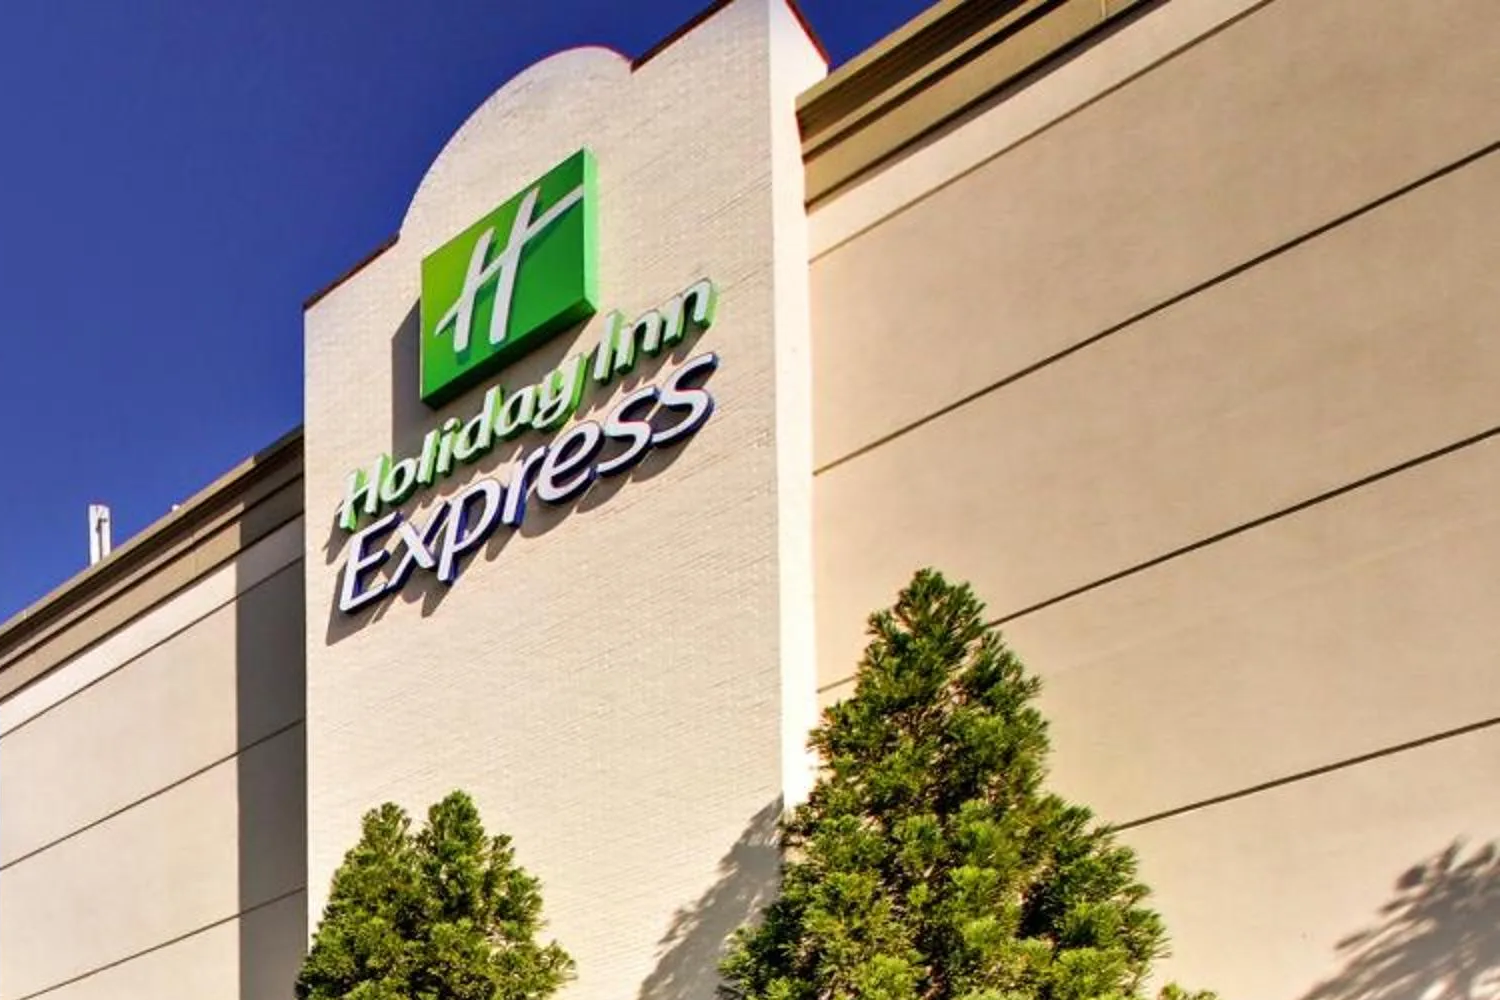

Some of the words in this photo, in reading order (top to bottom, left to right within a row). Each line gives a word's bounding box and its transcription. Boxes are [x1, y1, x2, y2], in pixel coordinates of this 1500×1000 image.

[435, 186, 584, 353] H
[337, 352, 587, 532] Holiday
[593, 277, 717, 384] Inn
[338, 351, 719, 614] Express
